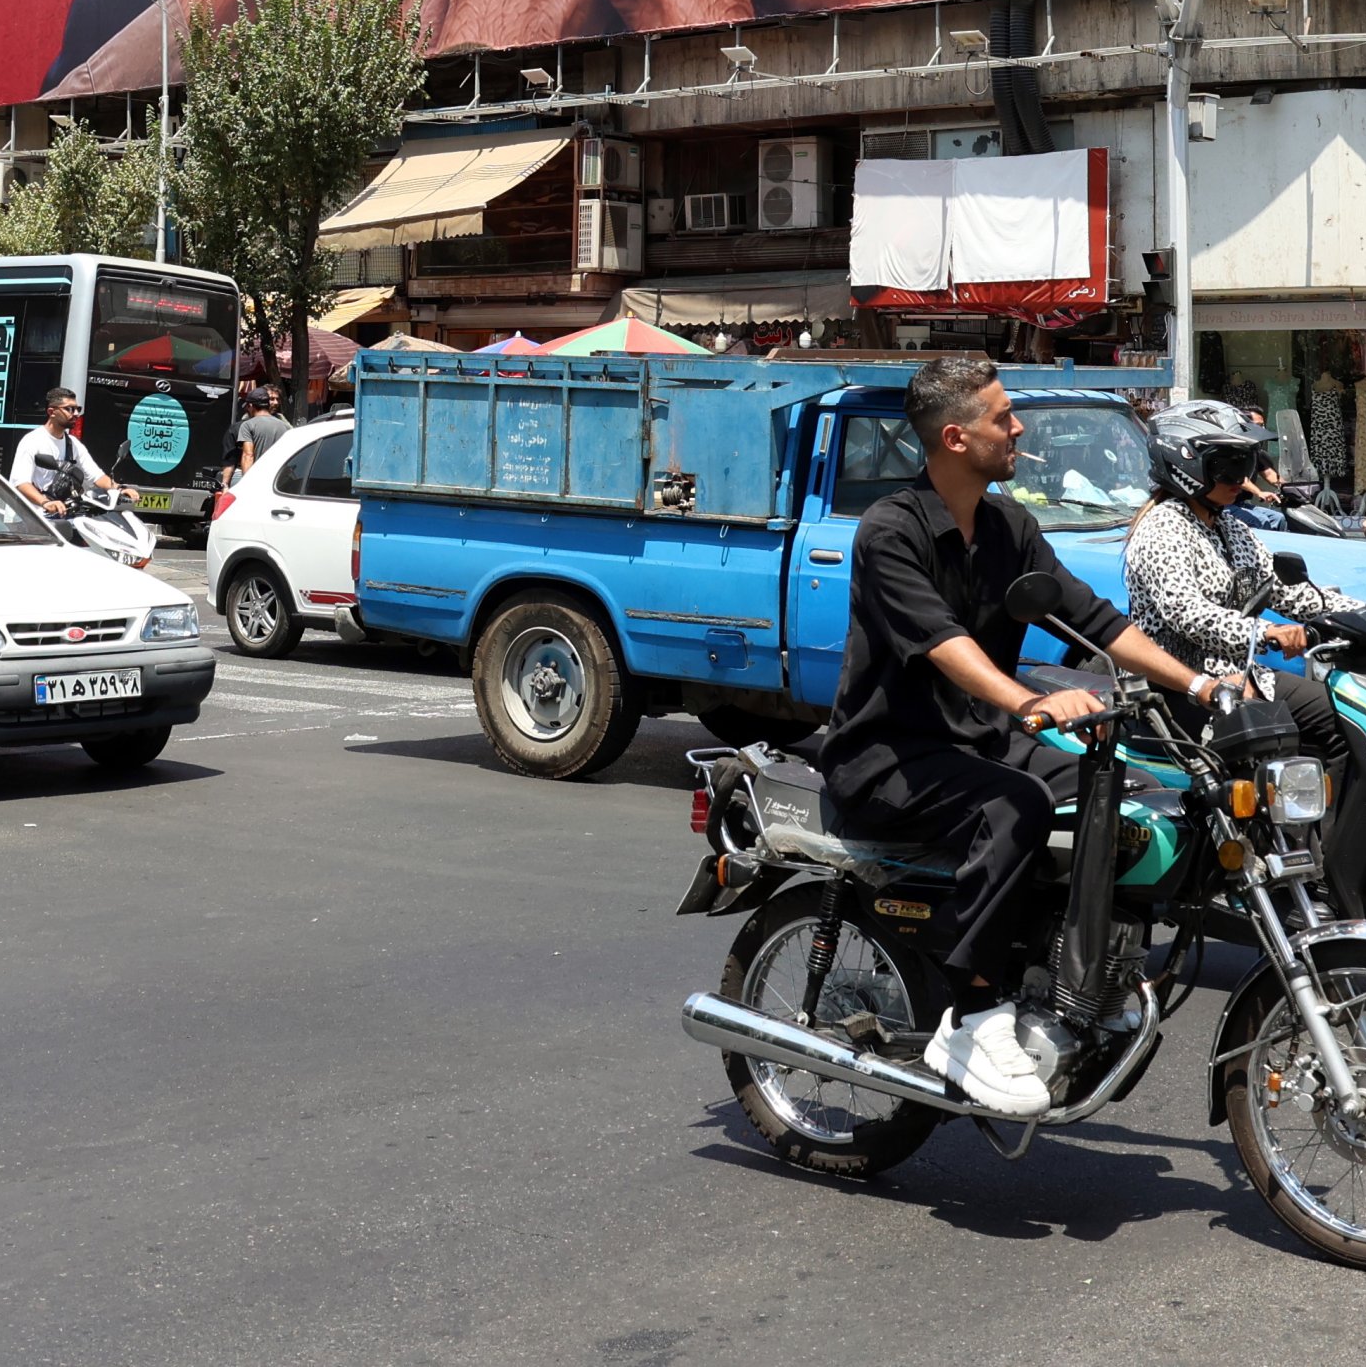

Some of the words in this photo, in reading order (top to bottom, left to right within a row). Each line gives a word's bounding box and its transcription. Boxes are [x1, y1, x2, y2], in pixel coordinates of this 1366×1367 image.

[1068, 285, 1096, 299] رضی
[1229, 311, 1265, 324] Shiva
[1269, 310, 1305, 323] Shiva
[1311, 309, 1348, 322] Shiva
[145, 415, 173, 429] چشم
[143, 427, 173, 439] تهران
[143, 438, 172, 452] روشن
